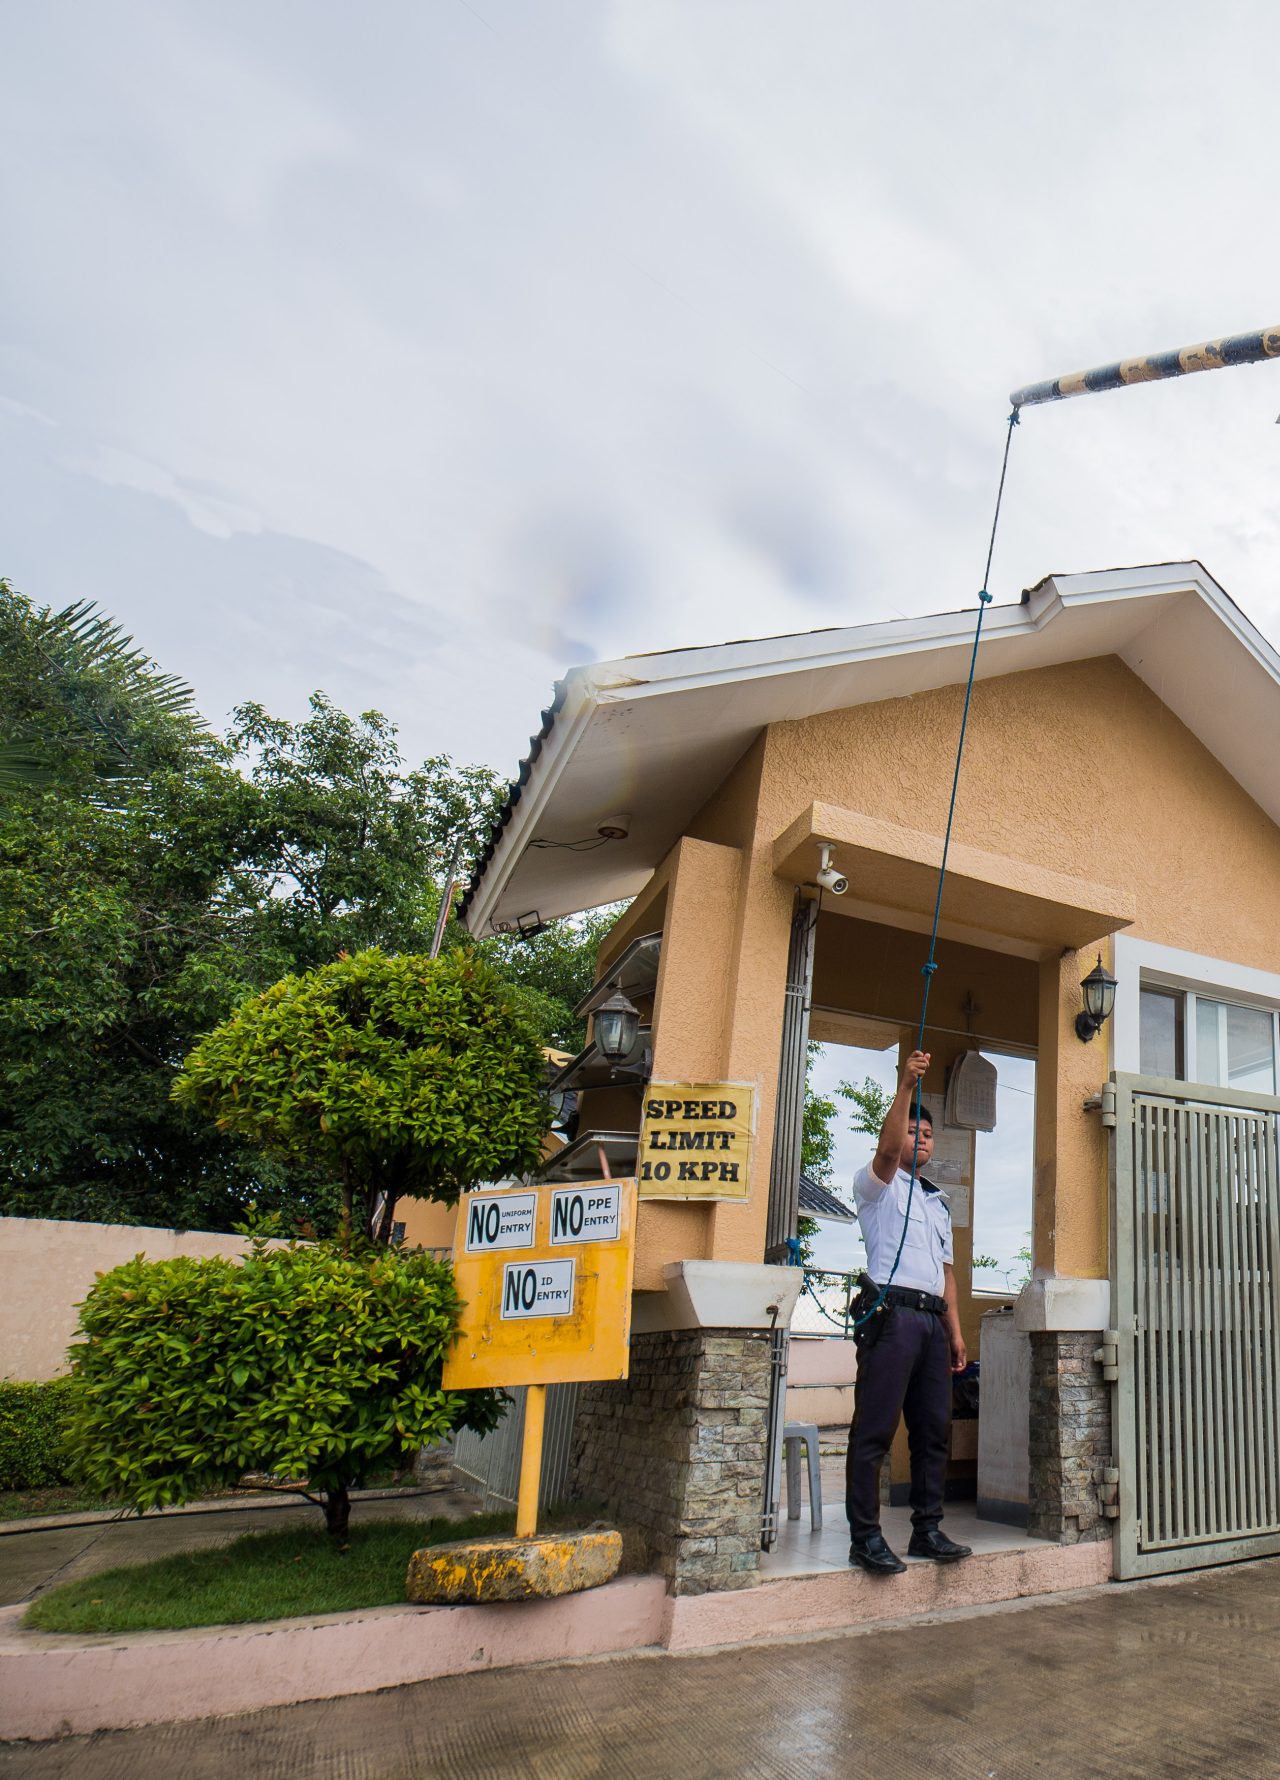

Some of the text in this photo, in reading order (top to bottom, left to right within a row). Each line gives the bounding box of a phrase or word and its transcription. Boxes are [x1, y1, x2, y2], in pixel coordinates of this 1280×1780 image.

[646, 1099, 737, 1120] SPEED
[649, 1130, 736, 1151] LIMIT
[641, 1161, 740, 1183] 10 KPH
[588, 1197, 612, 1211] PPE
[501, 1209, 532, 1218] UNIFORM
[554, 1194, 584, 1238] NO
[584, 1215, 616, 1226] ENTRY
[470, 1202, 500, 1245] NO
[500, 1223, 531, 1234] ENTRY
[541, 1276, 553, 1286] ID
[505, 1268, 537, 1312] NO
[537, 1289, 569, 1301] ENTRY
